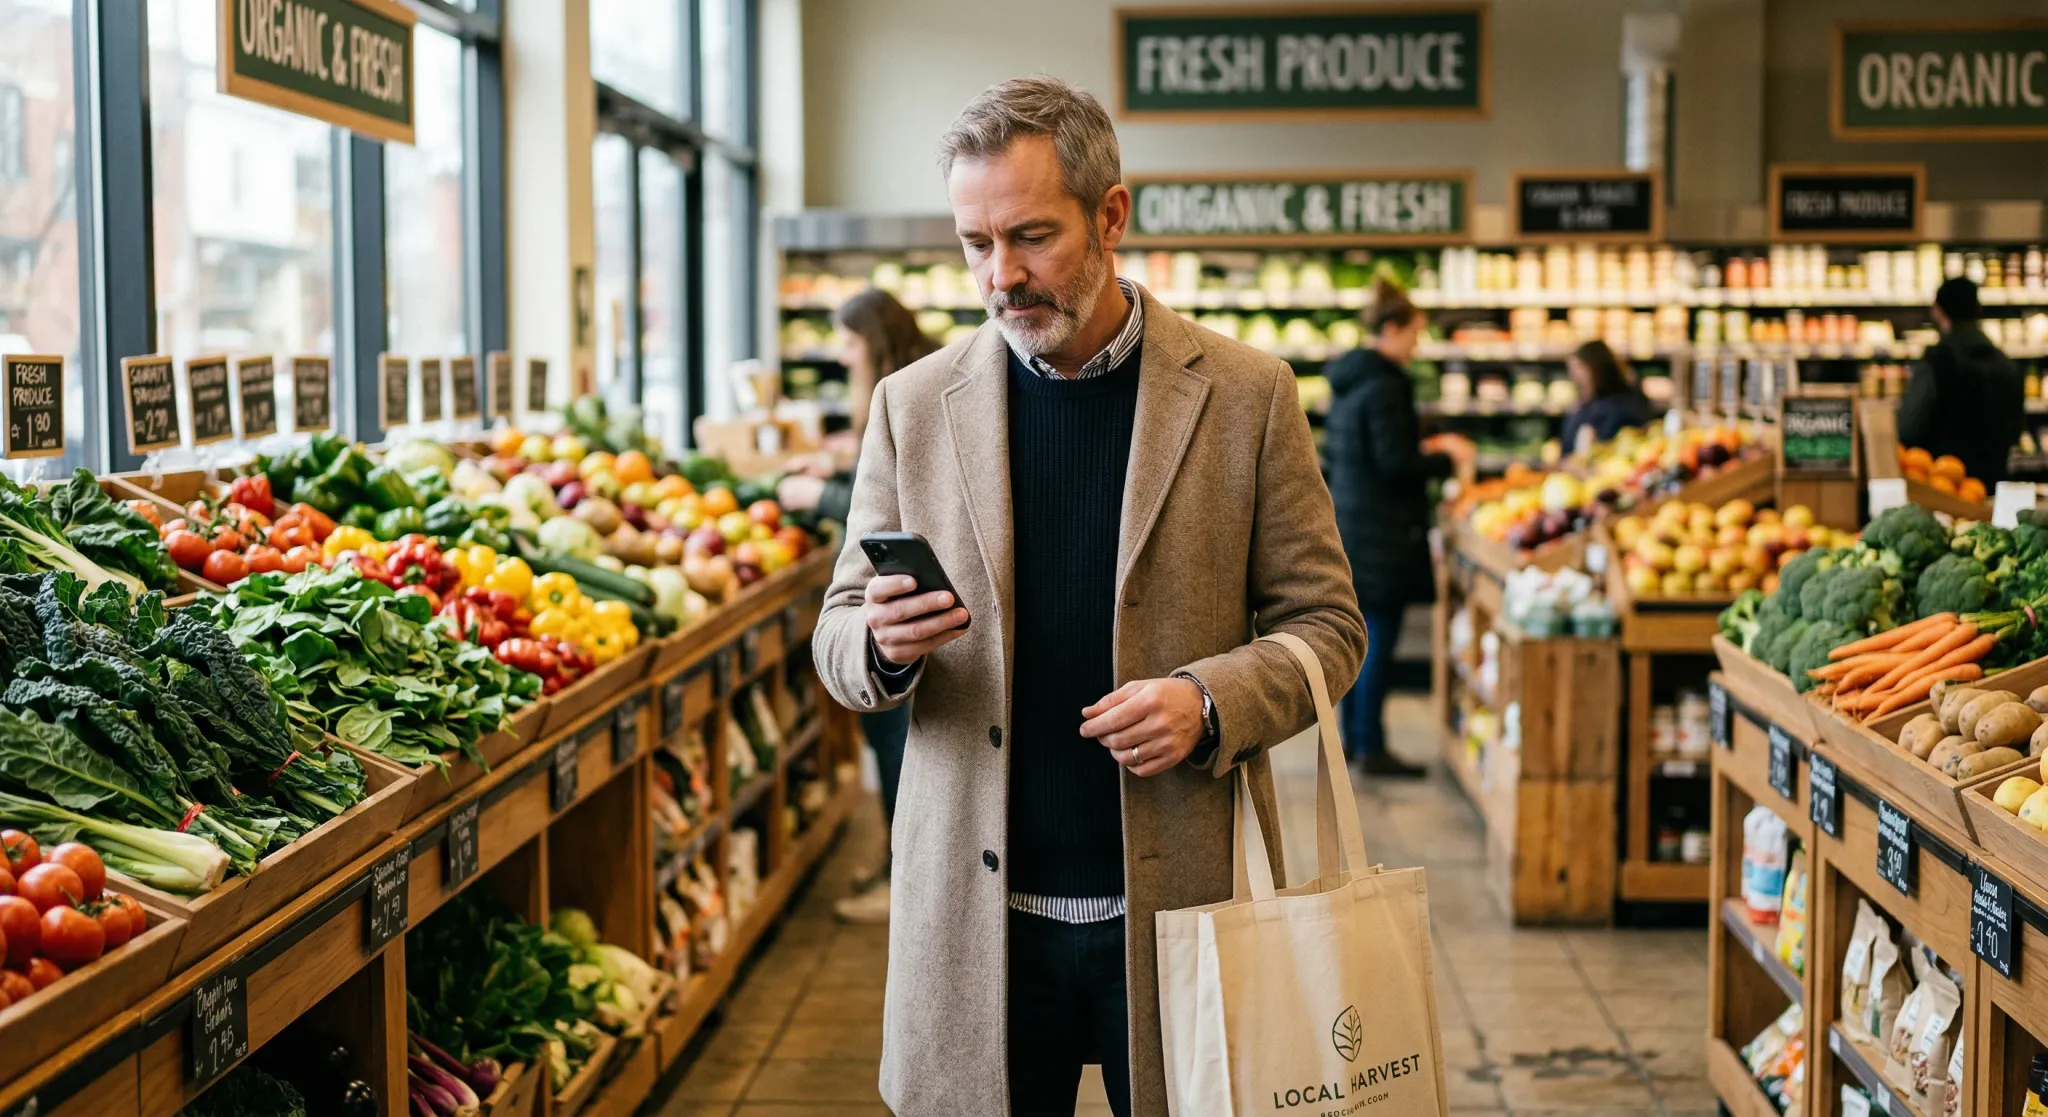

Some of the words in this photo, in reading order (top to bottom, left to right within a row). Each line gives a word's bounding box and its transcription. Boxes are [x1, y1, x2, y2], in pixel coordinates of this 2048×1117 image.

[239, 0, 329, 81] ORGANIC
[332, 22, 348, 86] &
[351, 26, 403, 104] FRESH
[1137, 35, 1265, 93] FRESH
[1276, 32, 1465, 92] PRODUCE
[1858, 52, 2046, 109] ORGANIC
[1138, 183, 1296, 234] ORGANIC
[1302, 184, 1334, 232] &
[1341, 182, 1451, 232] FRESH
[15, 364, 47, 384] FRESH
[1273, 1083, 1345, 1110] LOCAL
[1351, 1054, 1420, 1095] HARVEST
